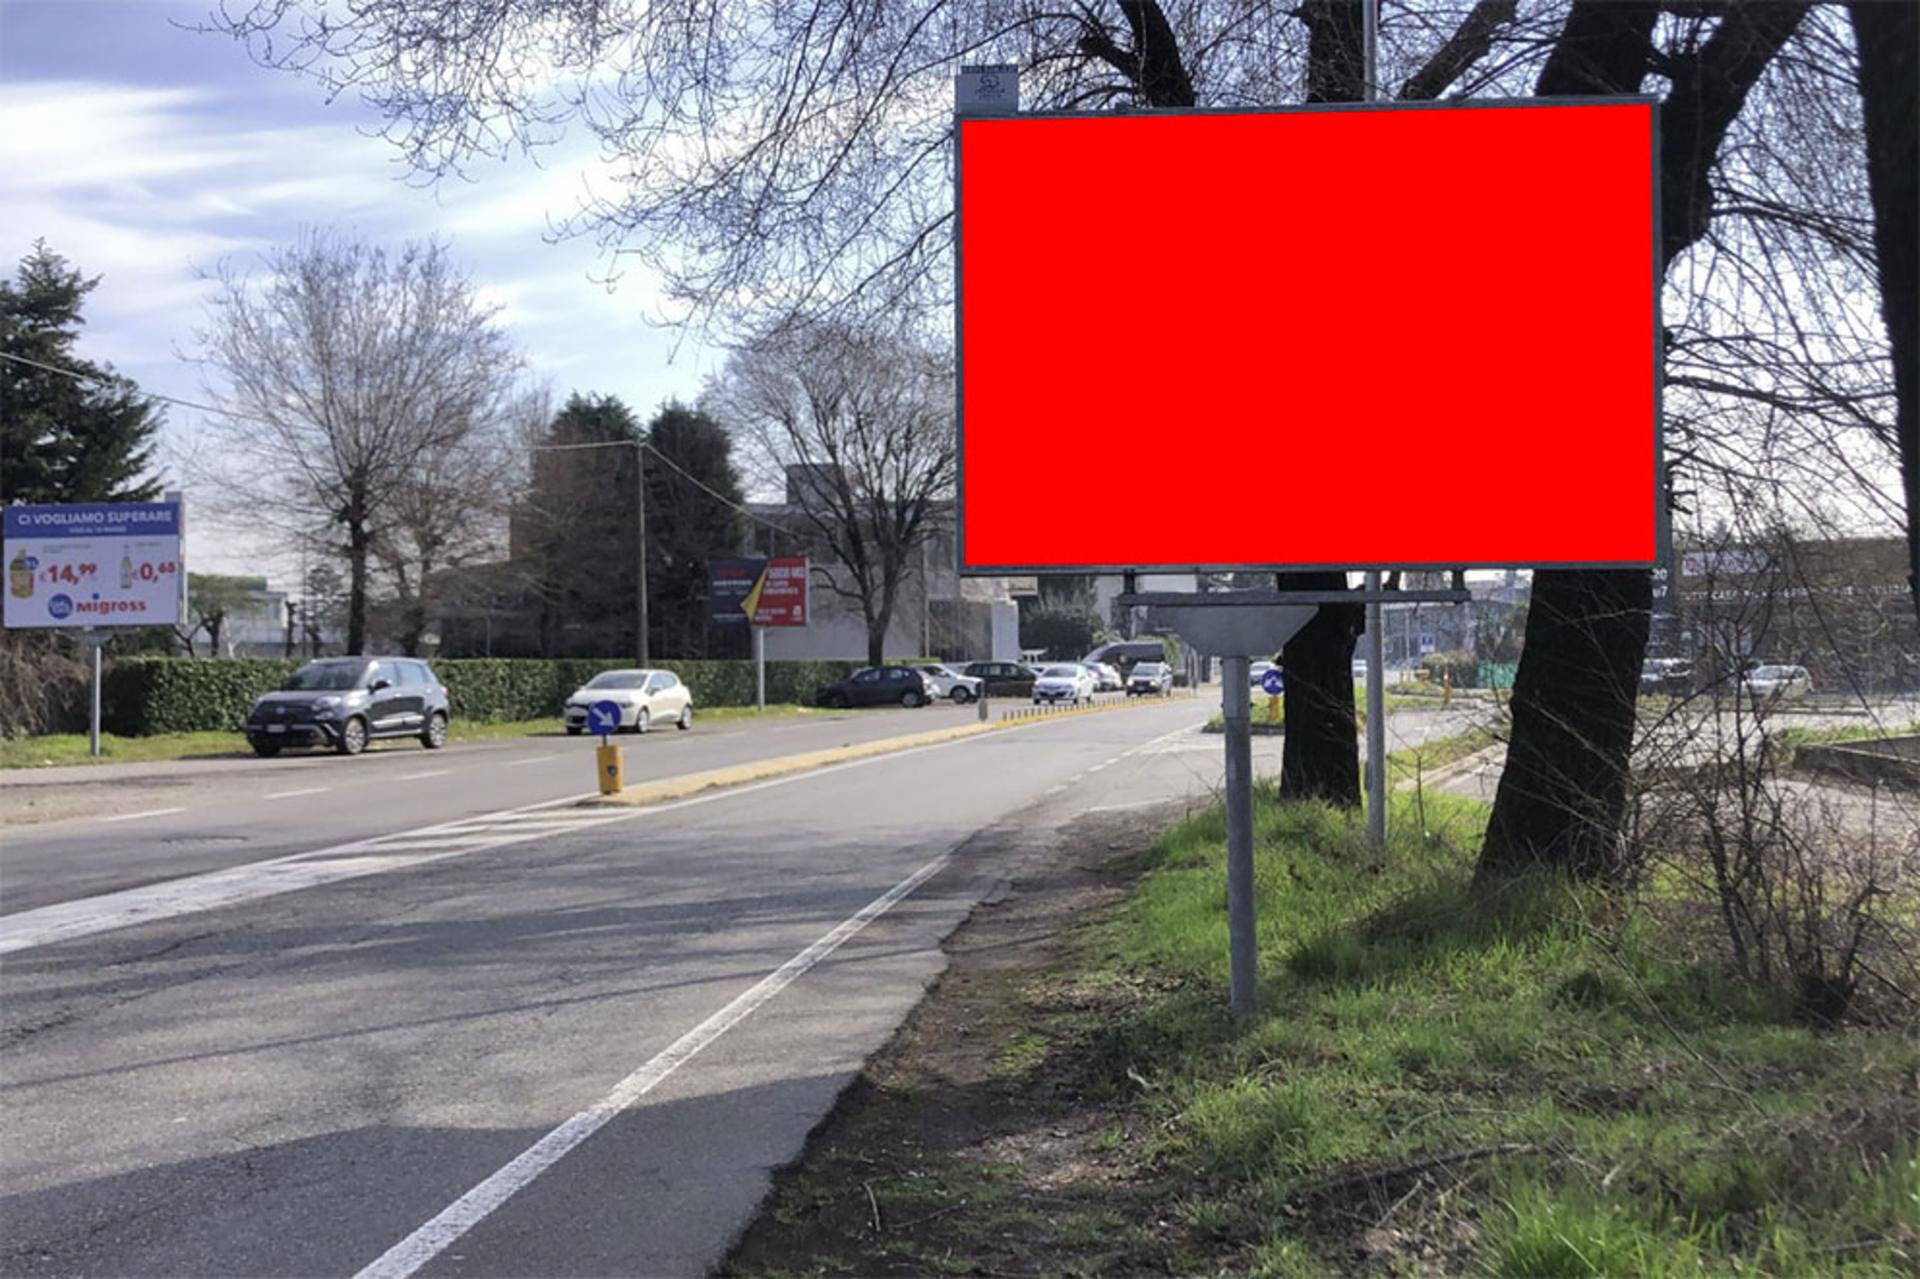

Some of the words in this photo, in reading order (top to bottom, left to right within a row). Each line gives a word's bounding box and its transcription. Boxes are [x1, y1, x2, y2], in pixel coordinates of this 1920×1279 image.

[33, 511, 105, 525] VOGLIAMO
[108, 510, 172, 523] SUPERARE
[76, 592, 147, 615] migross
